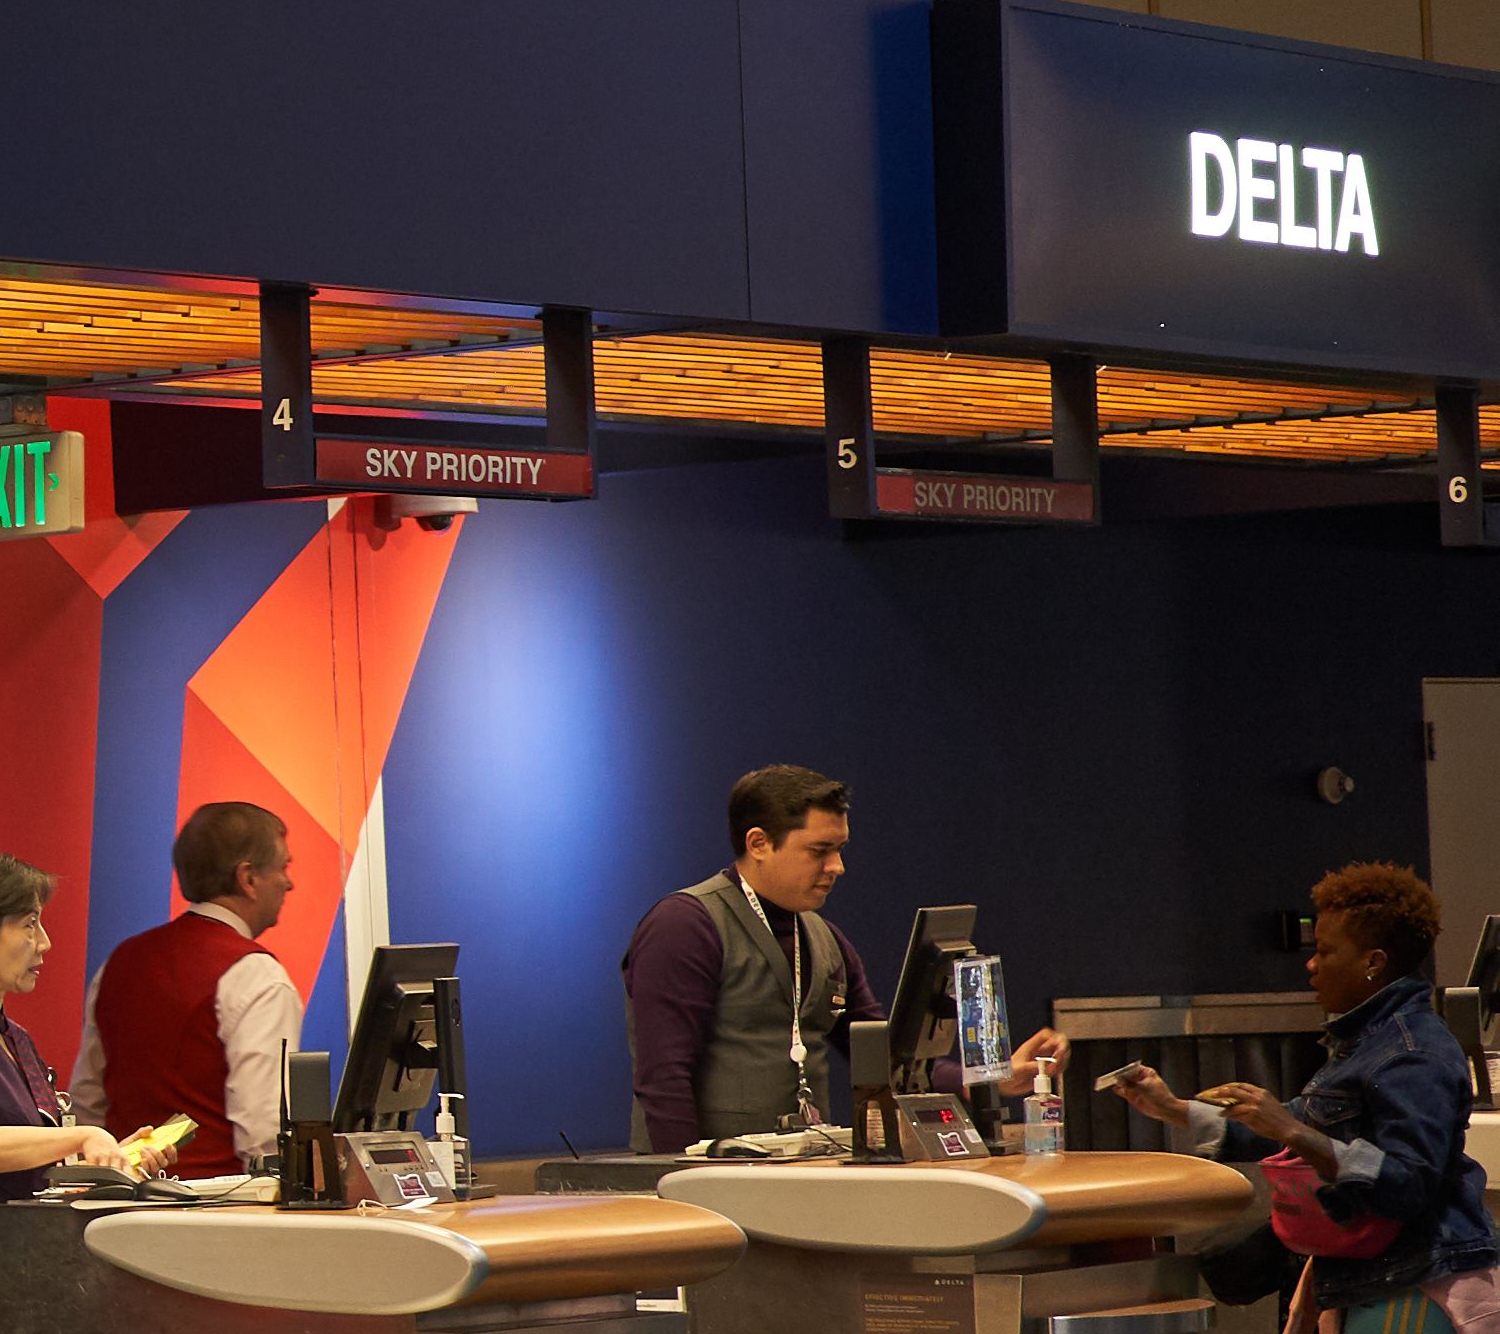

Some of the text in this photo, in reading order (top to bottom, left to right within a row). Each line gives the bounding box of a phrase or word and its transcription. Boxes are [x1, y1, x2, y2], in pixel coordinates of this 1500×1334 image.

[1189, 131, 1379, 256] DELTA
[272, 398, 293, 431] 4
[365, 447, 543, 485] SKY PRIORITY
[837, 437, 857, 469] 5
[913, 480, 1055, 515] SKY PRIORITY
[1449, 476, 1468, 504] 6
